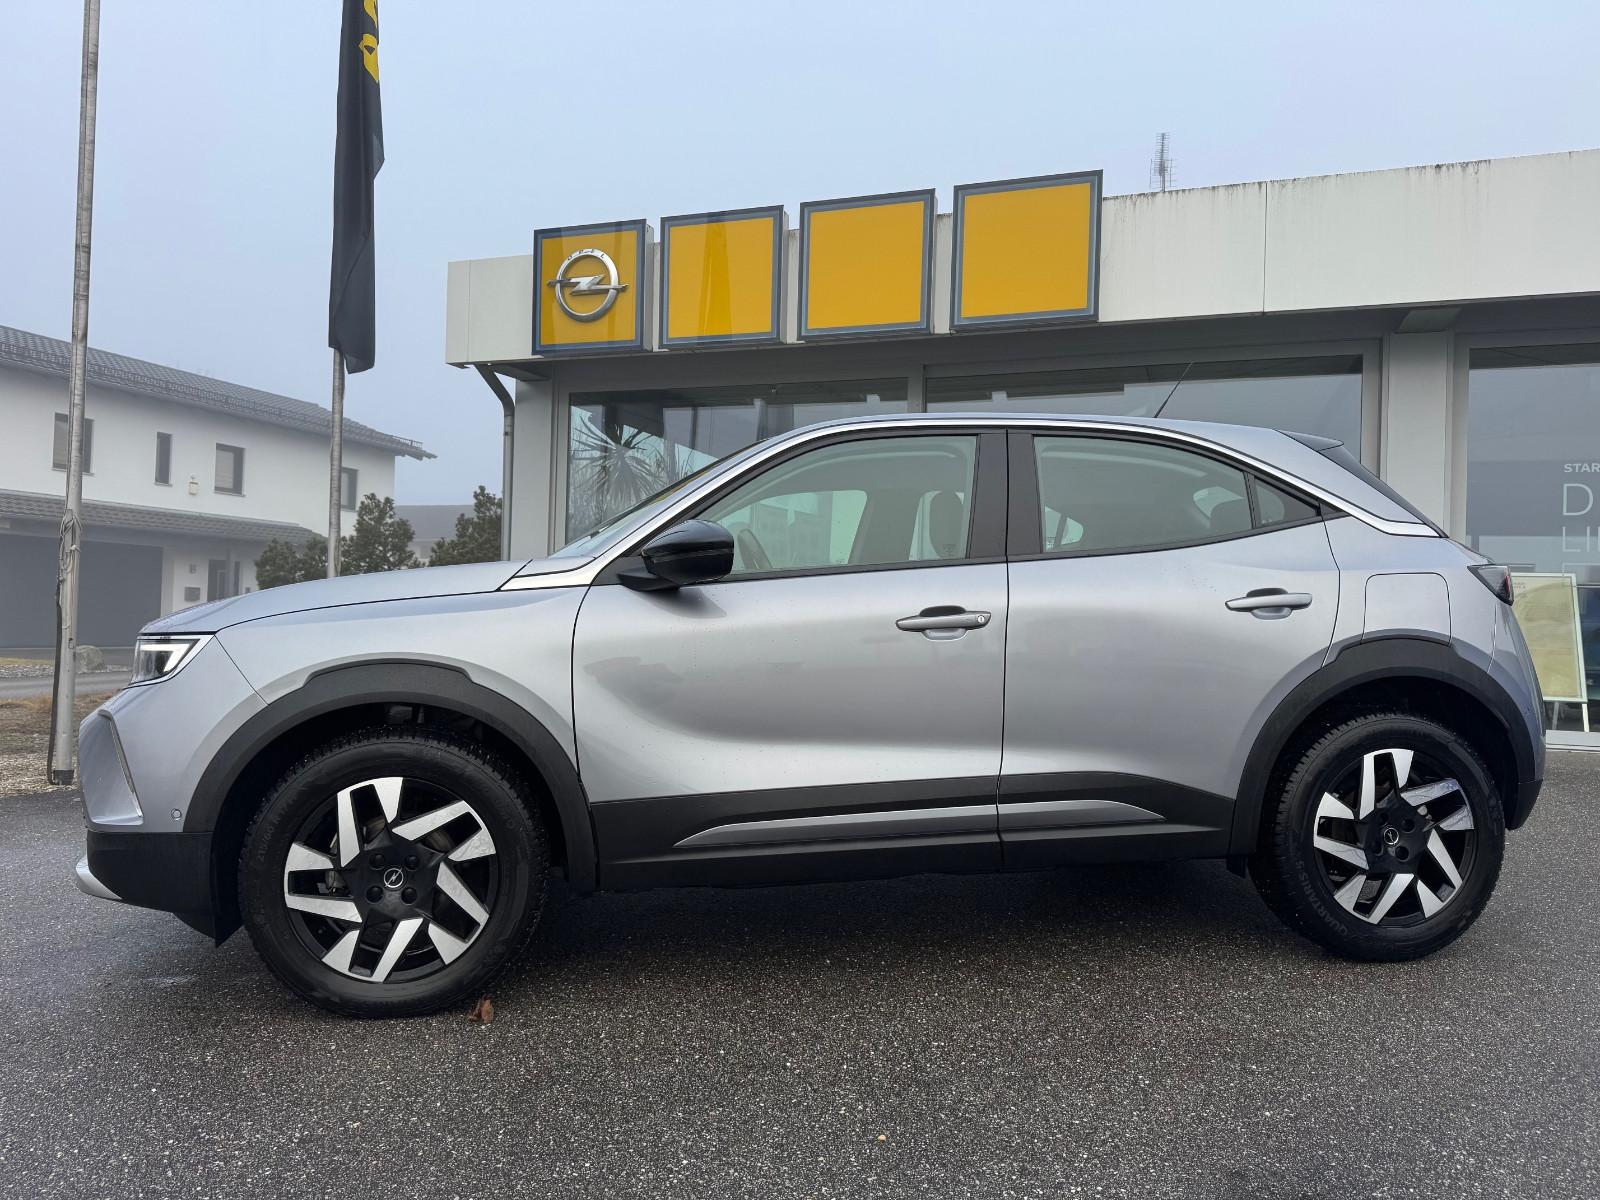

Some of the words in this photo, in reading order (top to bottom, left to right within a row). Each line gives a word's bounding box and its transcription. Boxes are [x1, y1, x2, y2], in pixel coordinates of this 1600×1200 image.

[1563, 463, 1600, 473] STAR
[1562, 483, 1594, 516] D
[1298, 871, 1348, 936] QUARTARIS
